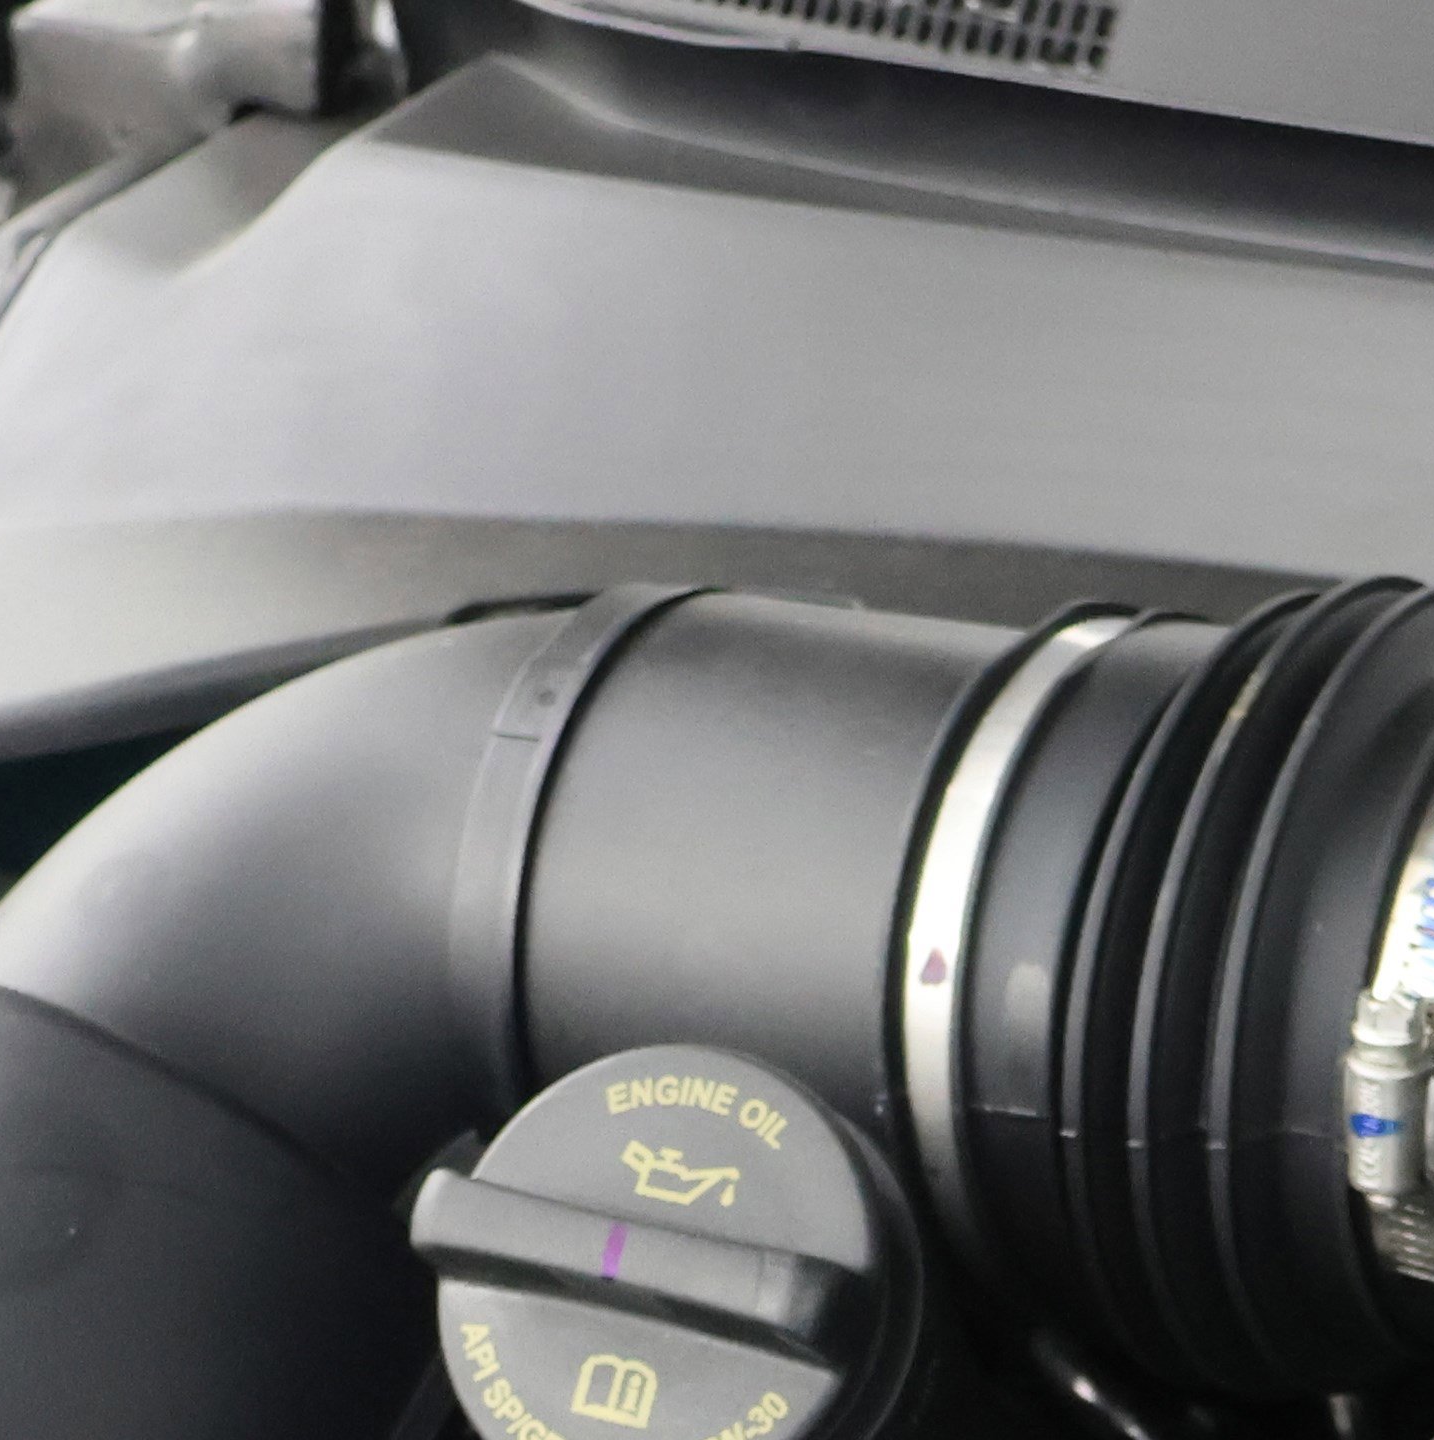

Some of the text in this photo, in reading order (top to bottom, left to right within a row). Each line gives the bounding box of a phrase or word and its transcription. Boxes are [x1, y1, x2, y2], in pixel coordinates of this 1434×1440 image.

[606, 1074, 789, 1150] ENGINE OIL
[460, 1322, 500, 1382] API
